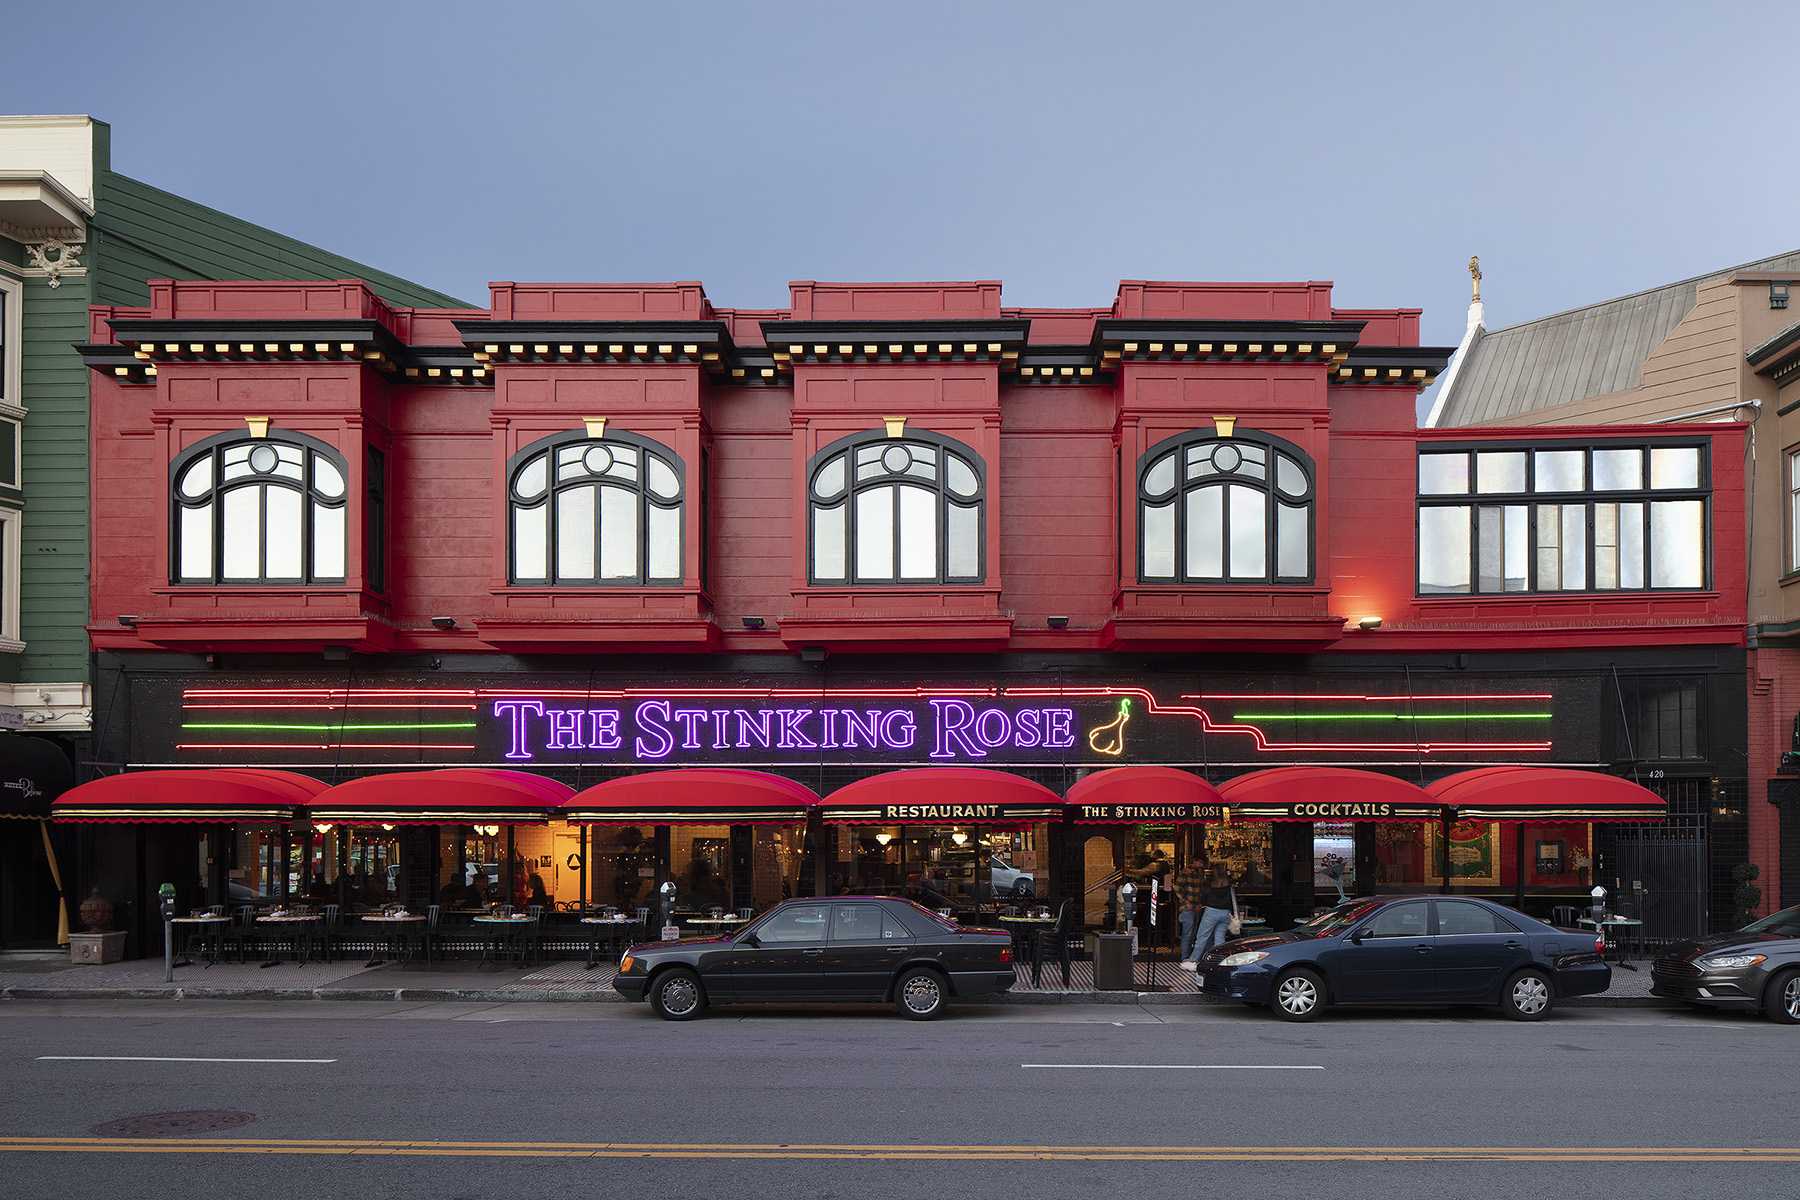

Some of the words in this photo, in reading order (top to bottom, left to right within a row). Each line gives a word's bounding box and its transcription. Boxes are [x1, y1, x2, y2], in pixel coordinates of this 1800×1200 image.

[494, 700, 622, 758] THE
[635, 700, 917, 758] STINKING
[929, 699, 1075, 758] ROSE
[1649, 770, 1664, 778] 420
[886, 805, 999, 818] RESTAURANT
[1082, 805, 1108, 818] THE
[1115, 805, 1186, 819] STINKING
[1192, 804, 1221, 817] ROSE
[1293, 803, 1390, 816] COCKTAILS
